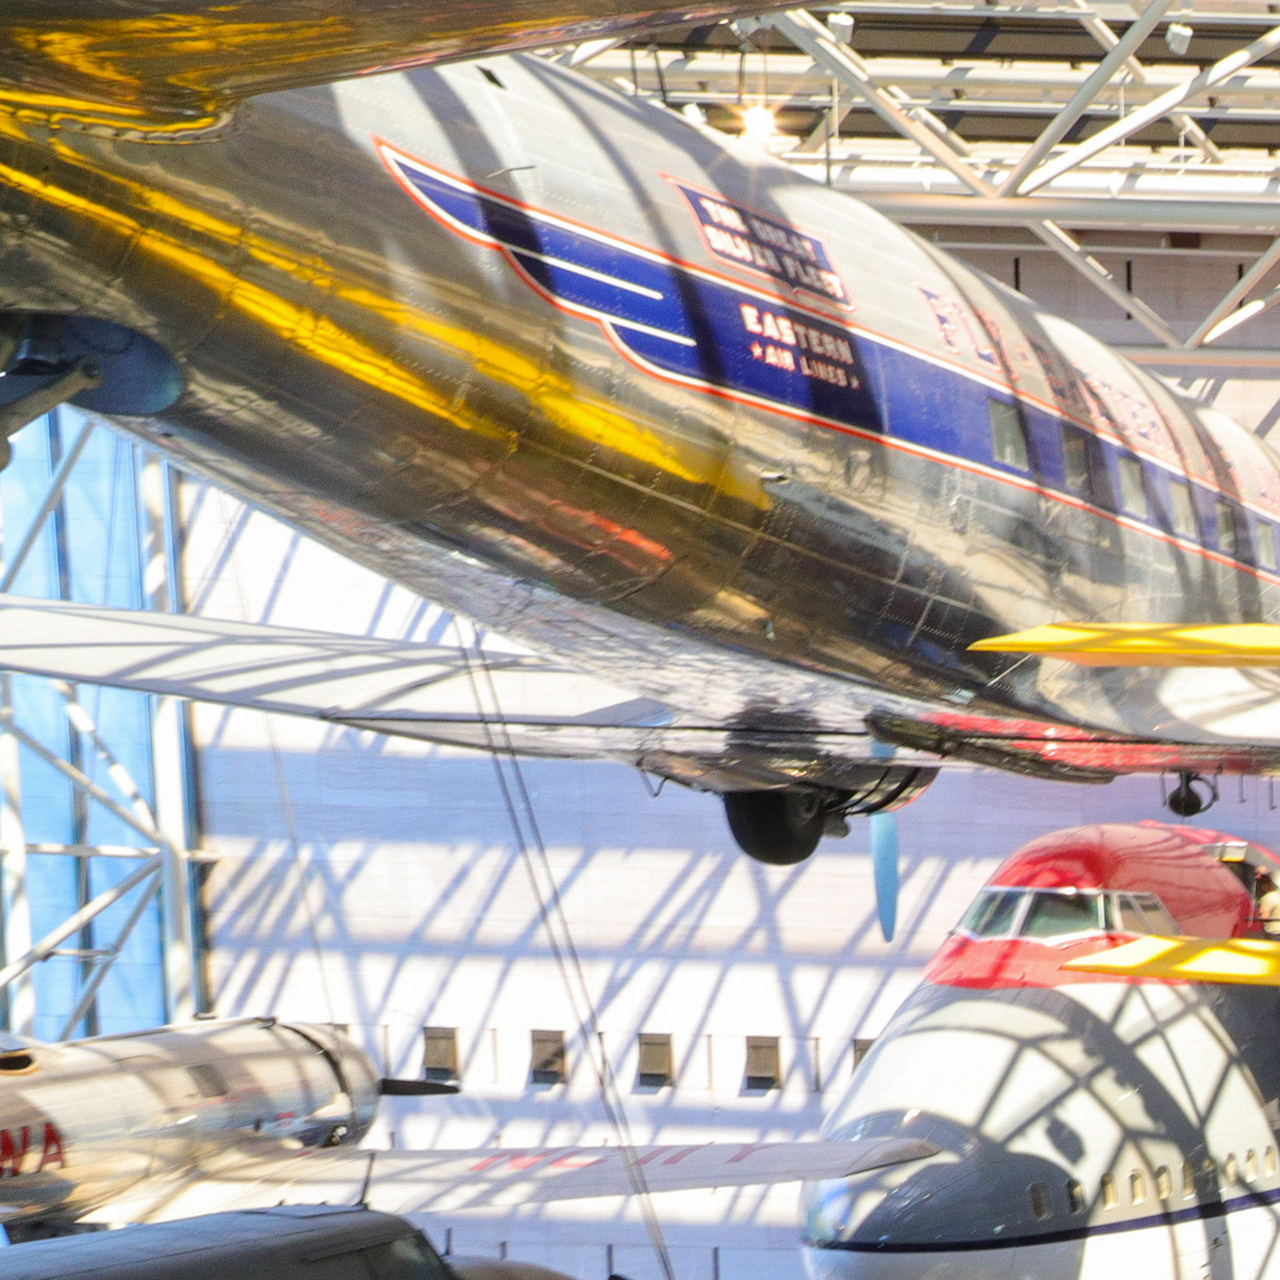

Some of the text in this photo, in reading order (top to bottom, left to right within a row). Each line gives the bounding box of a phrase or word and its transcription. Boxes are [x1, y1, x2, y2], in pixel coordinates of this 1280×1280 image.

[739, 303, 855, 365] EASTERN
[764, 344, 848, 387] AIR LINES
